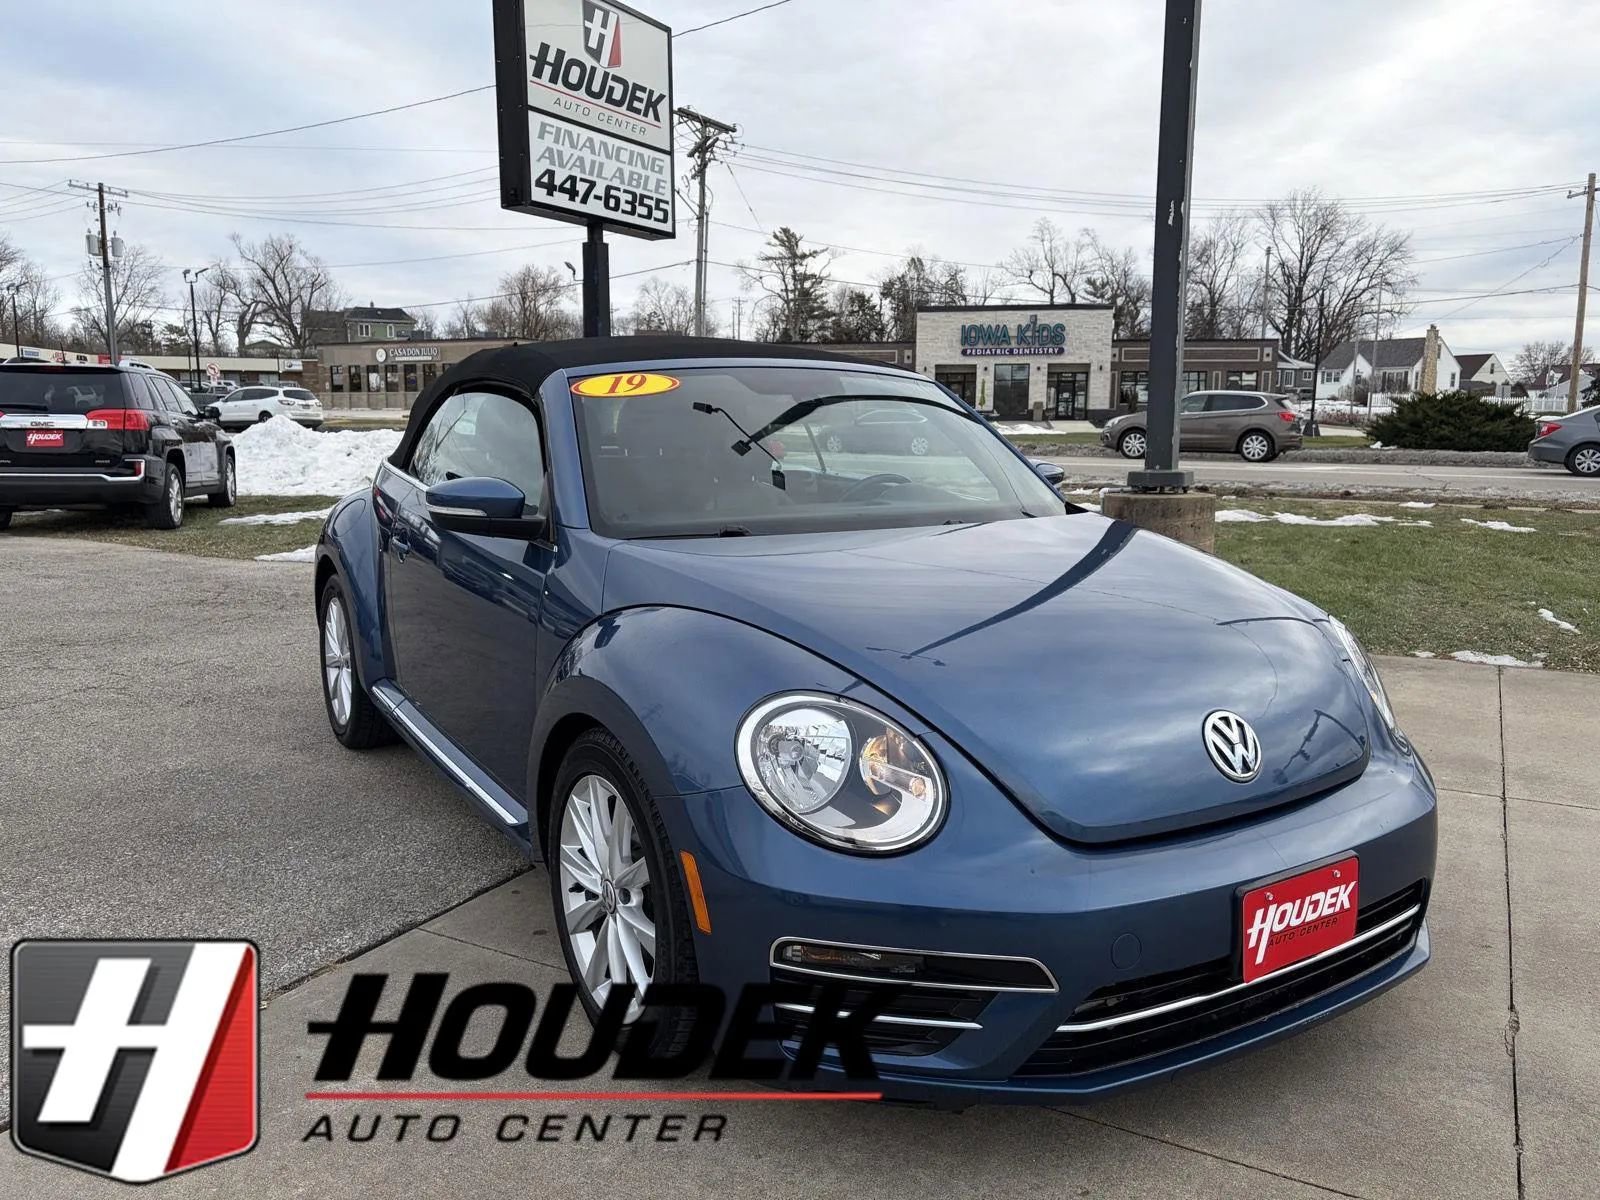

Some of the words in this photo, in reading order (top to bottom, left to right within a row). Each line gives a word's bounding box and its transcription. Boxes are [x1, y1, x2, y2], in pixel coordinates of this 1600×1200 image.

[529, 42, 666, 123] HOUDEK
[553, 97, 591, 117] AUTO
[597, 112, 647, 136] CENTER
[537, 121, 665, 175] FINANCING
[536, 147, 667, 197] AVAILABLE
[534, 168, 669, 224] 447-6355
[389, 347, 406, 357] CASA
[407, 347, 420, 356] DON
[421, 347, 438, 356] JULIO
[961, 324, 1011, 346] IOWA
[1013, 347, 1060, 355] DENTISTRY
[603, 374, 648, 395] 19
[27, 432, 63, 445] HOUDEK
[1247, 880, 1358, 966] HOUDEK
[1268, 931, 1296, 948] AUTO
[1299, 917, 1338, 937] CENTER
